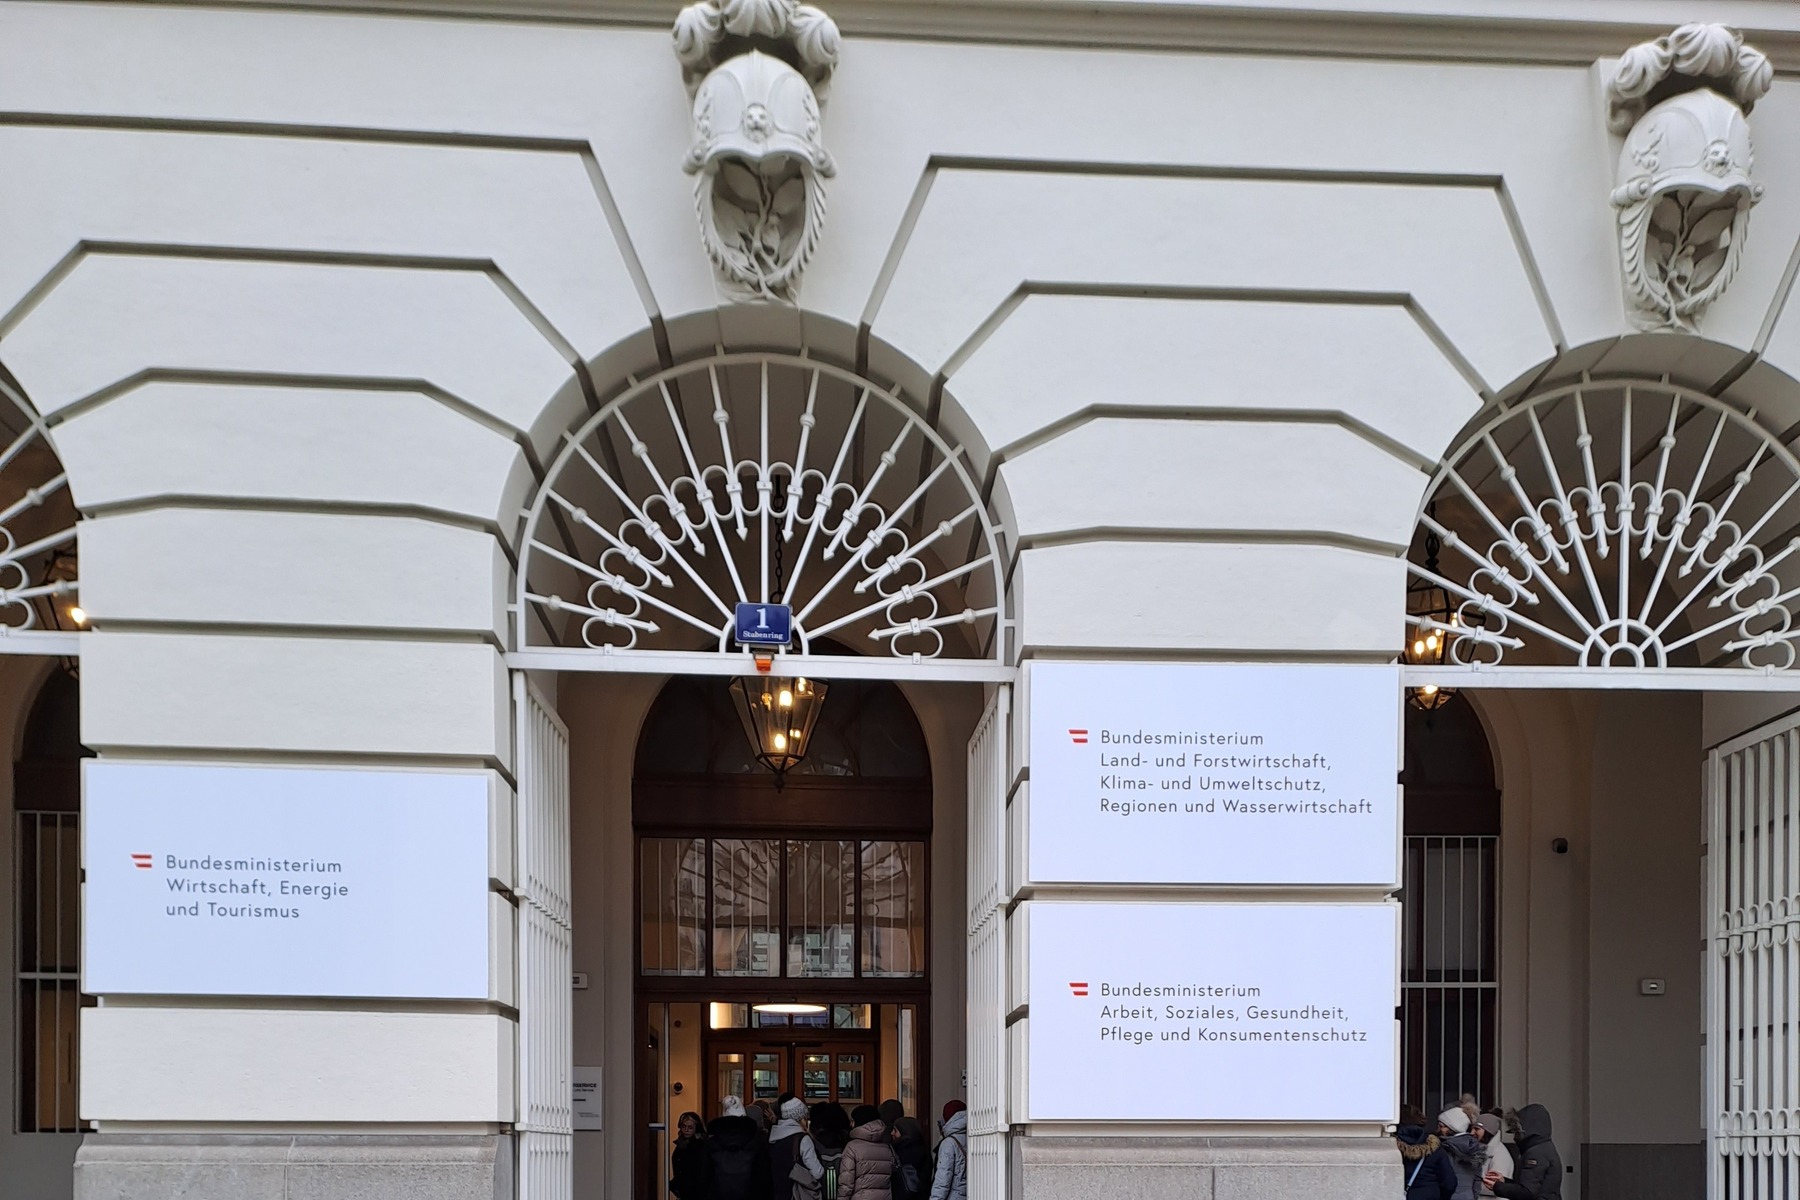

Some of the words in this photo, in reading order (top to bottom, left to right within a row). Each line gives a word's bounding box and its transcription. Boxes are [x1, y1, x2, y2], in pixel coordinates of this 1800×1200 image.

[756, 607, 770, 629] 1
[1101, 729, 1264, 746] Bundesministerium
[1100, 752, 1148, 768] Land-
[1155, 753, 1186, 768] und
[1193, 753, 1331, 771] Forstwirtschaft,
[1100, 775, 1154, 790] Klima-
[1161, 774, 1192, 791] und
[1199, 775, 1326, 793] Umweltschutz,
[1100, 797, 1178, 817] Regionen
[1184, 797, 1215, 814] und
[1222, 798, 1373, 814] Wasserwirtschaft
[166, 854, 342, 873] Bundesministerium
[166, 877, 272, 897] Wirtschaft,
[280, 880, 349, 901] Energie
[166, 900, 199, 917] und
[206, 901, 300, 919] Tourismus
[1101, 982, 1261, 998] Bundesministerium
[1100, 1004, 1158, 1022] Arbeit,
[1165, 1004, 1239, 1022] Soziales,
[1246, 1004, 1349, 1022] Gesundheit,
[1101, 1025, 1154, 1046] Pflege
[1160, 1026, 1191, 1042] und
[1198, 1026, 1367, 1042] Konsumentenschutz
